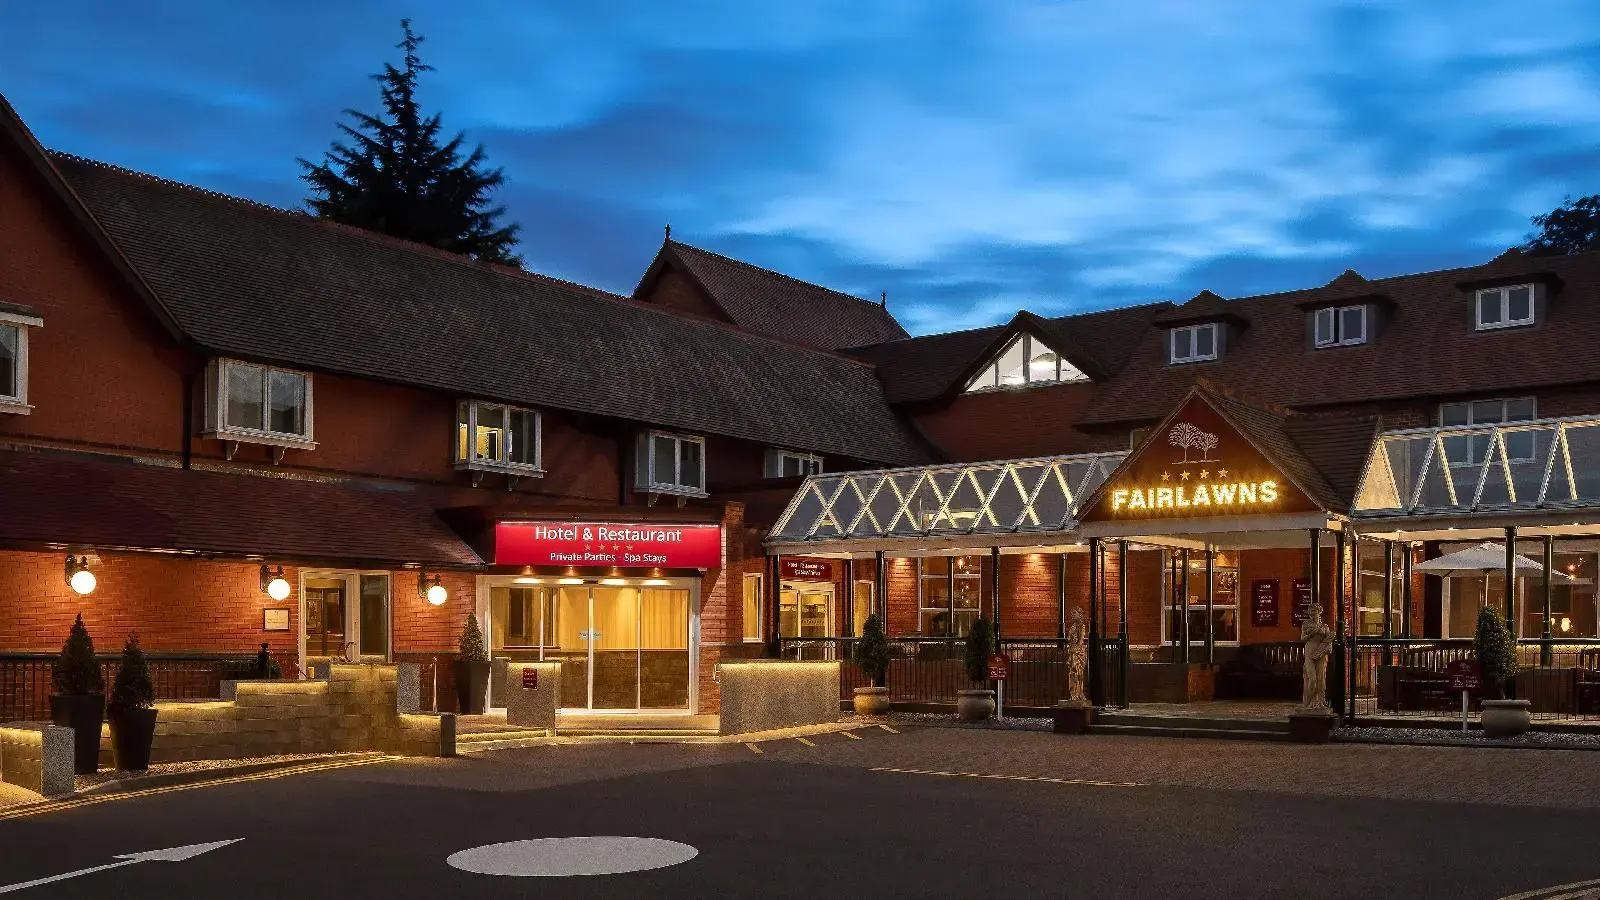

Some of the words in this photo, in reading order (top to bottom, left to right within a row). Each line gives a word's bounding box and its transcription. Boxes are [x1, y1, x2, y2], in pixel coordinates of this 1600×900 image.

[1111, 480, 1278, 510] FAIRLAWNS
[535, 526, 577, 541] Hotel
[582, 528, 593, 541] &
[598, 527, 682, 542] Restaurant
[550, 552, 582, 561] Private
[584, 552, 616, 562] Parties
[624, 553, 642, 563] Spa
[643, 553, 668, 563] Stays
